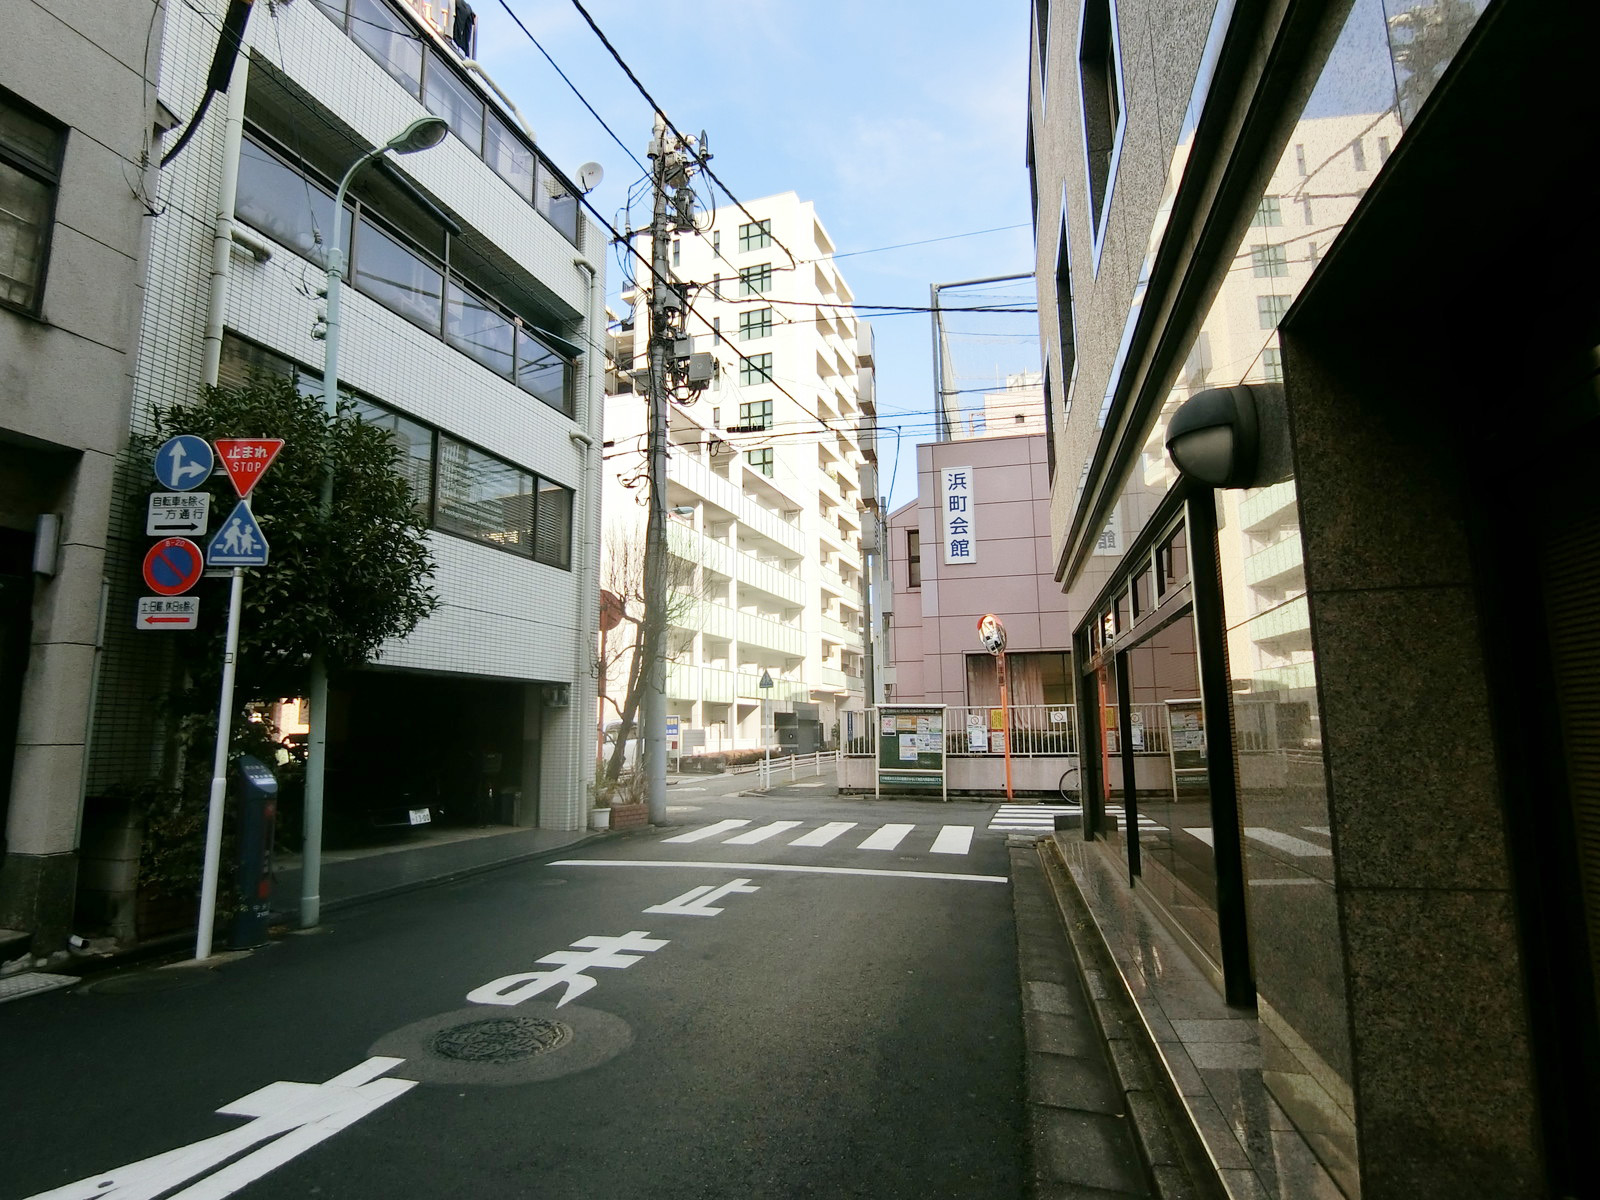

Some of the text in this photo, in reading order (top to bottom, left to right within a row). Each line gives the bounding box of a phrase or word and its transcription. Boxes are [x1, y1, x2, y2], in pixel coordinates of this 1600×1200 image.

[227, 445, 268, 459] 止まれ
[232, 461, 261, 473] STOP
[153, 495, 205, 507] 自転車を除く
[152, 508, 205, 520] 一方通行
[947, 472, 970, 557] 浜町会館
